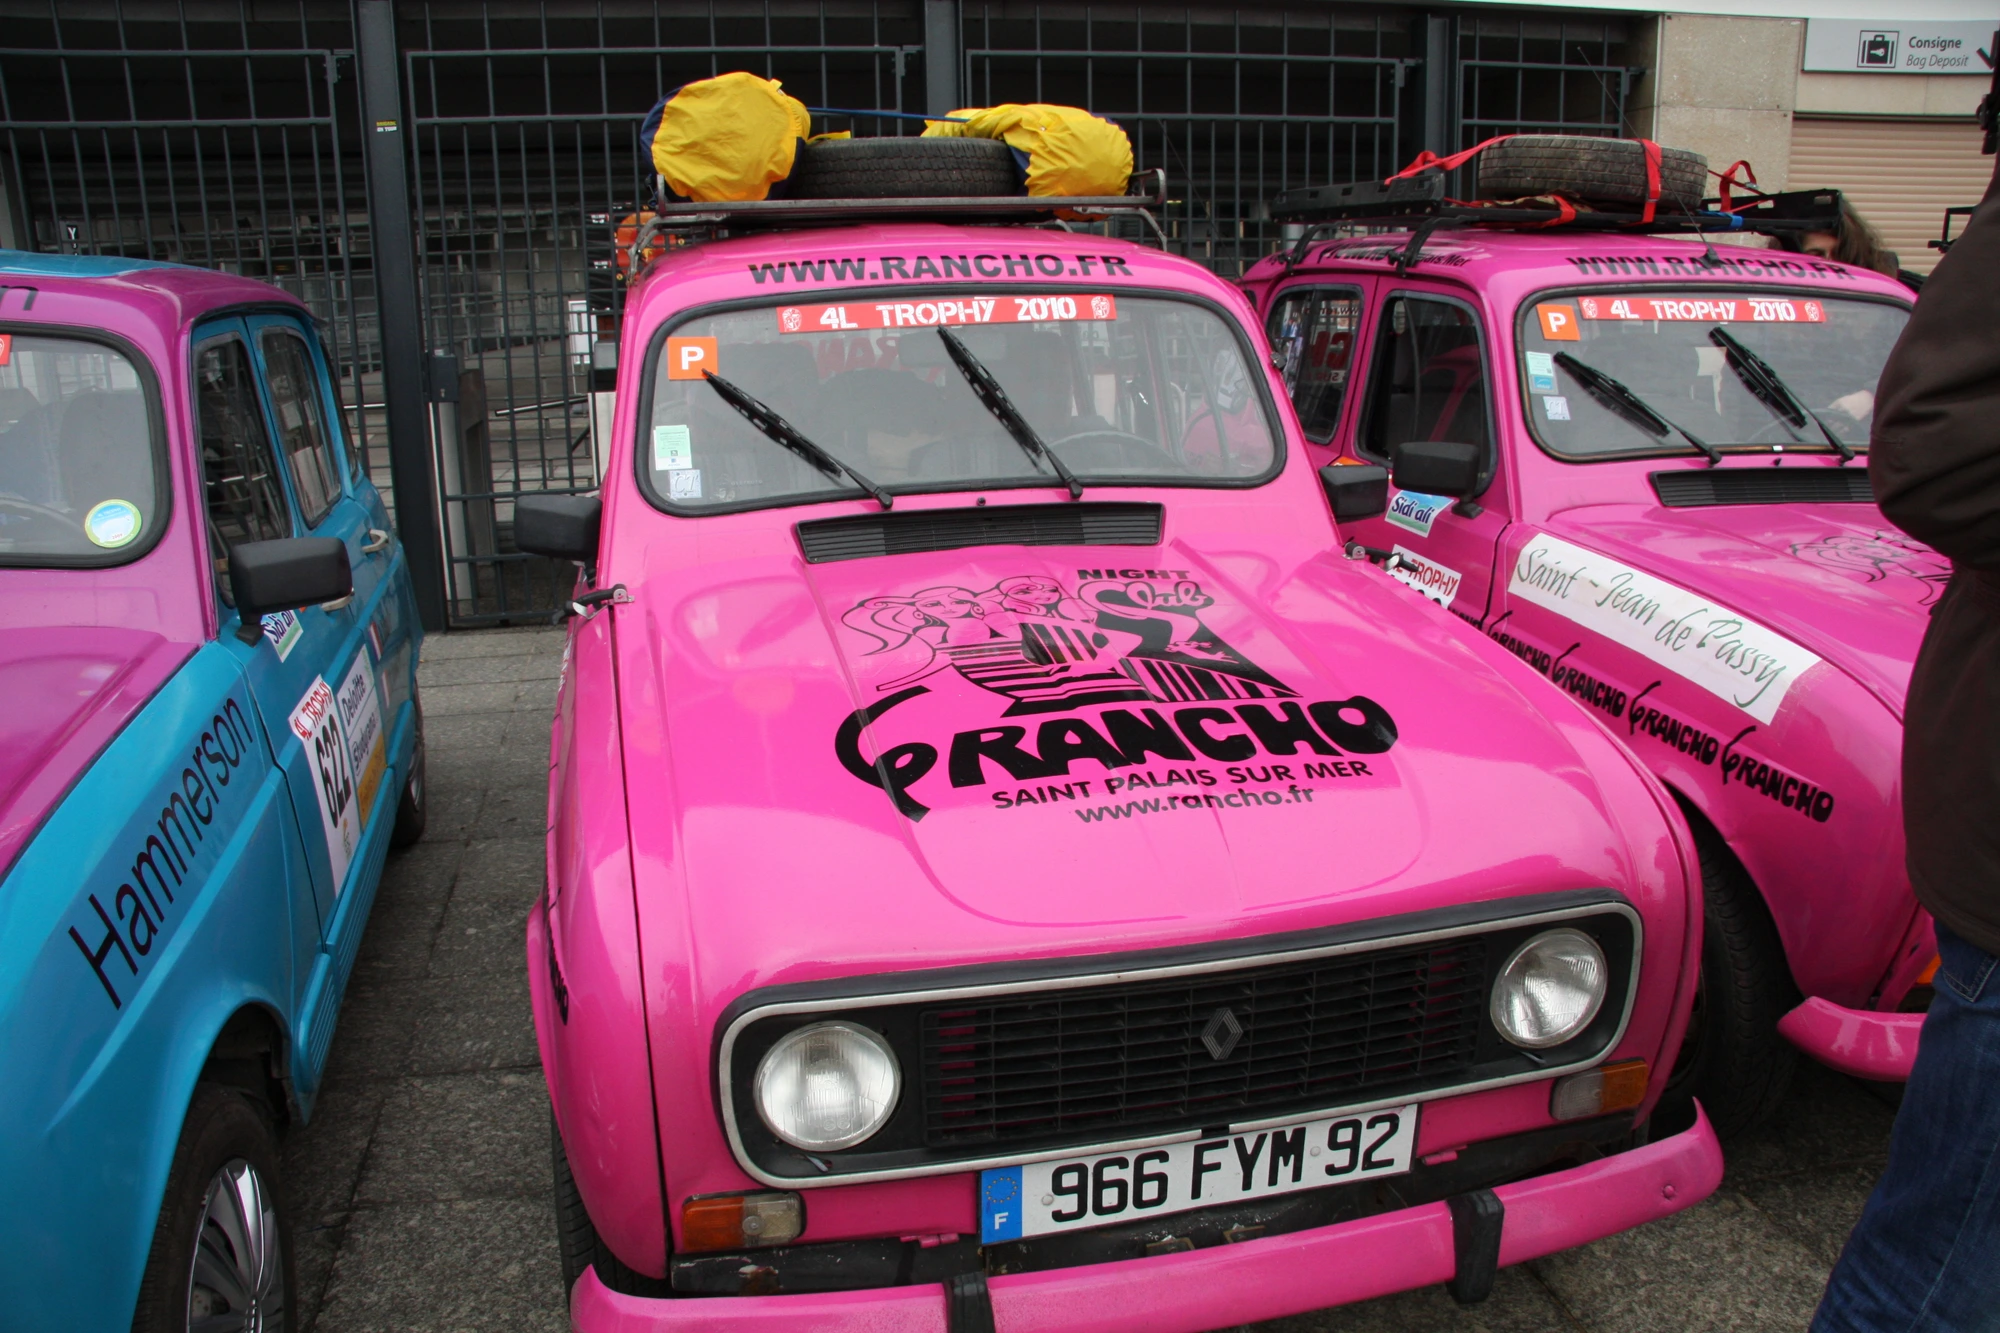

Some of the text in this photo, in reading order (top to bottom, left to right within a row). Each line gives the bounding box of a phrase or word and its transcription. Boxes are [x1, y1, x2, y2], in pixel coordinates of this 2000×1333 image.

[1908, 36, 1962, 51] Consigne
[1906, 54, 1969, 69] Bag Deposit
[748, 254, 1133, 284] WWW.RANCHO.FR
[1566, 257, 1856, 280] WWW.RANCHO.FR
[819, 296, 1077, 329] 4L TROPHY 2010
[1548, 312, 1567, 332] P
[1610, 300, 1797, 322] 4L TROPHY 2010
[681, 346, 705, 370] P
[1392, 497, 1435, 524] Sidi ali
[1077, 569, 1190, 580] NIGHT
[1408, 558, 1459, 597] TROPHY
[1078, 580, 1214, 618] Club
[1654, 608, 1708, 652] de
[1696, 618, 1787, 708] Passy
[302, 681, 333, 728] TROPHY
[315, 714, 352, 828] 622
[992, 759, 1374, 810] SAINT PALAIS SUR MER
[1076, 784, 1314, 824] www.rancho.fr
[68, 697, 253, 1011] Hammerson
[1051, 1113, 1401, 1223] 966 FYM 92
[994, 1212, 1009, 1230] F
